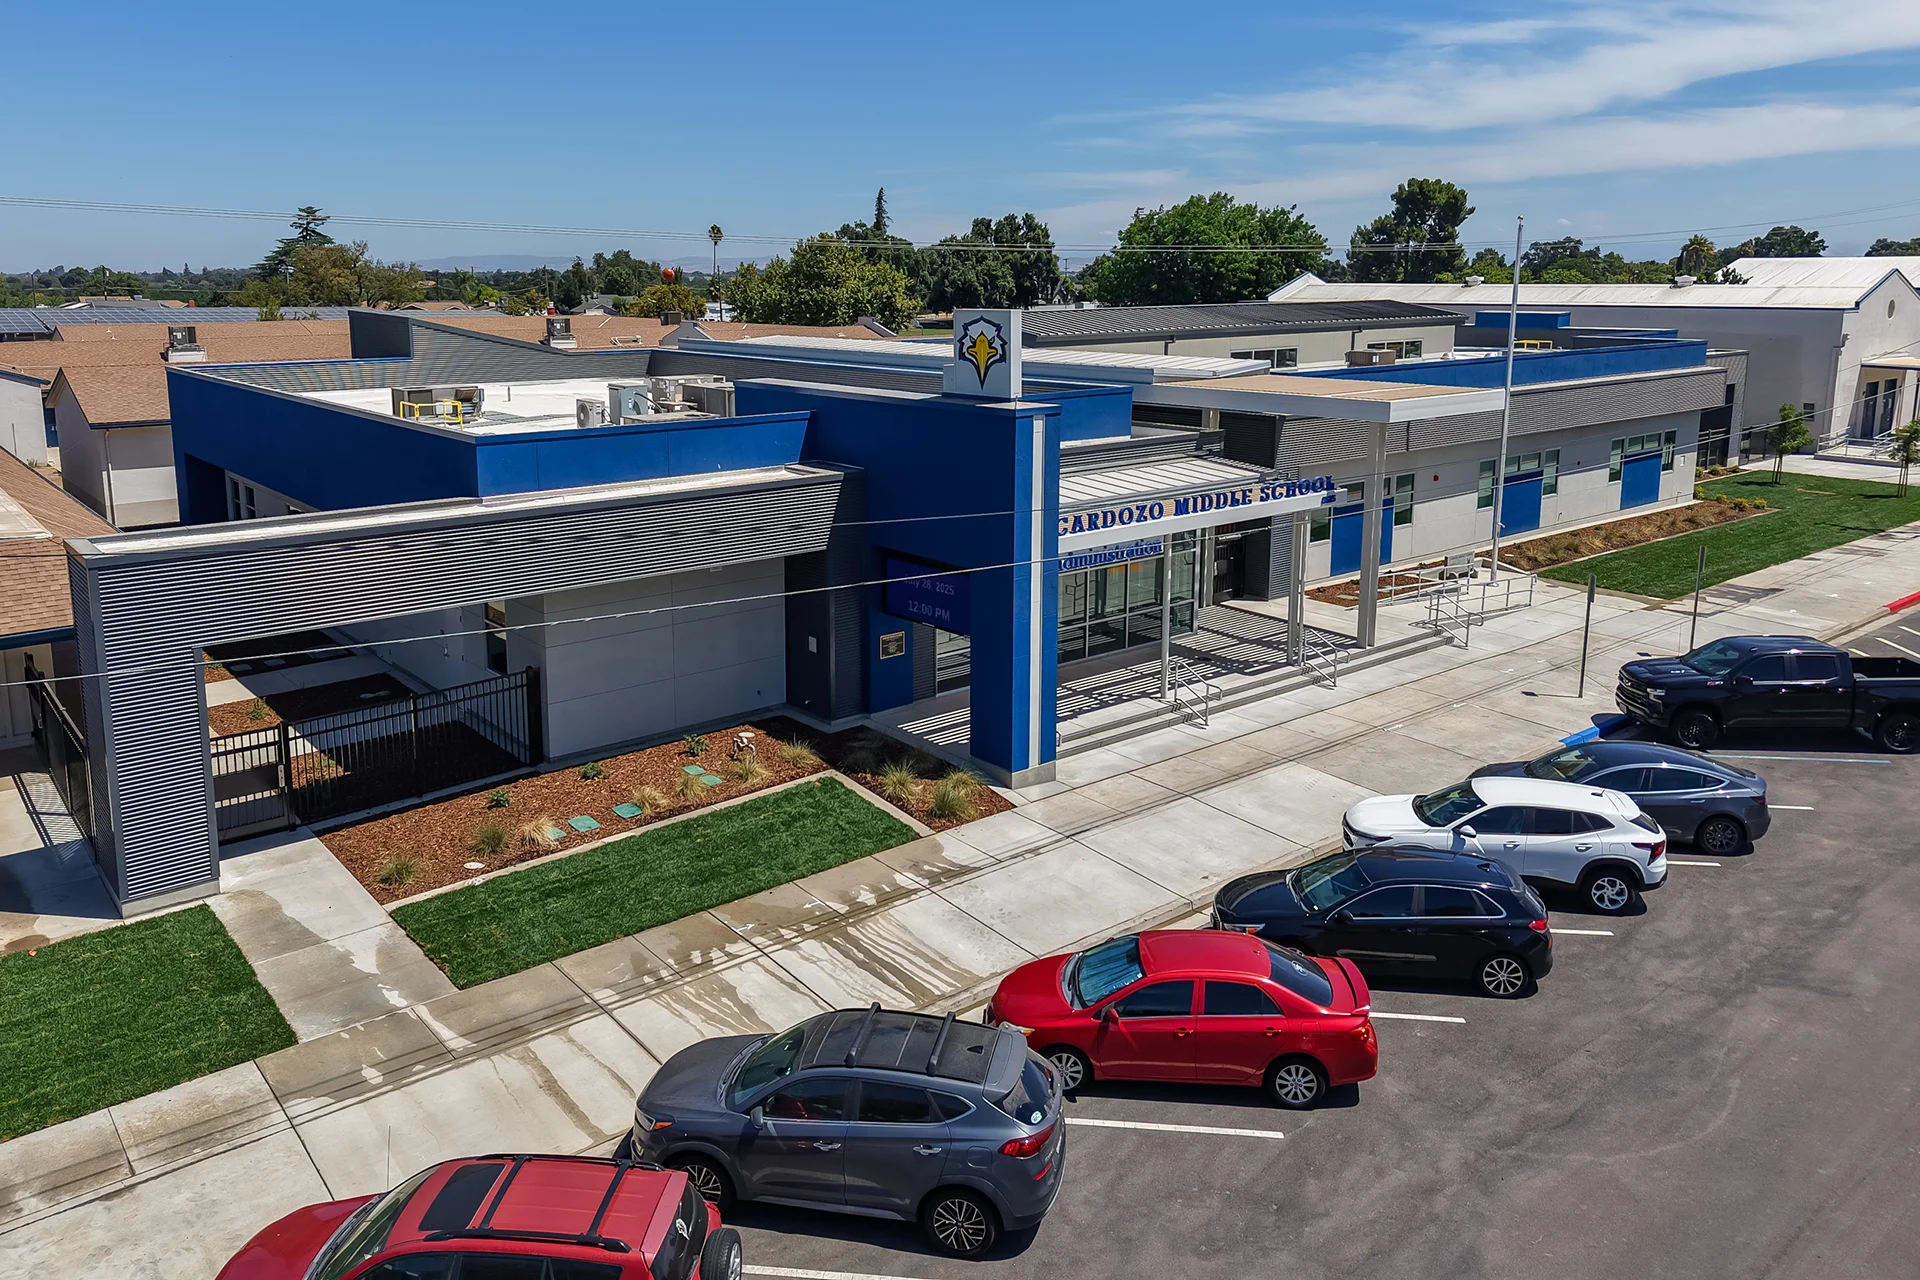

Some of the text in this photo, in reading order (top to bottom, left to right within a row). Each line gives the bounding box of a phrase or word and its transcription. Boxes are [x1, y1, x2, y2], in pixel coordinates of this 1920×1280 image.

[1058, 475, 1335, 537] CARDOZO MIDDLE SCHOOL
[936, 581, 955, 596] 2025
[908, 599, 950, 622] 12:00 PM
